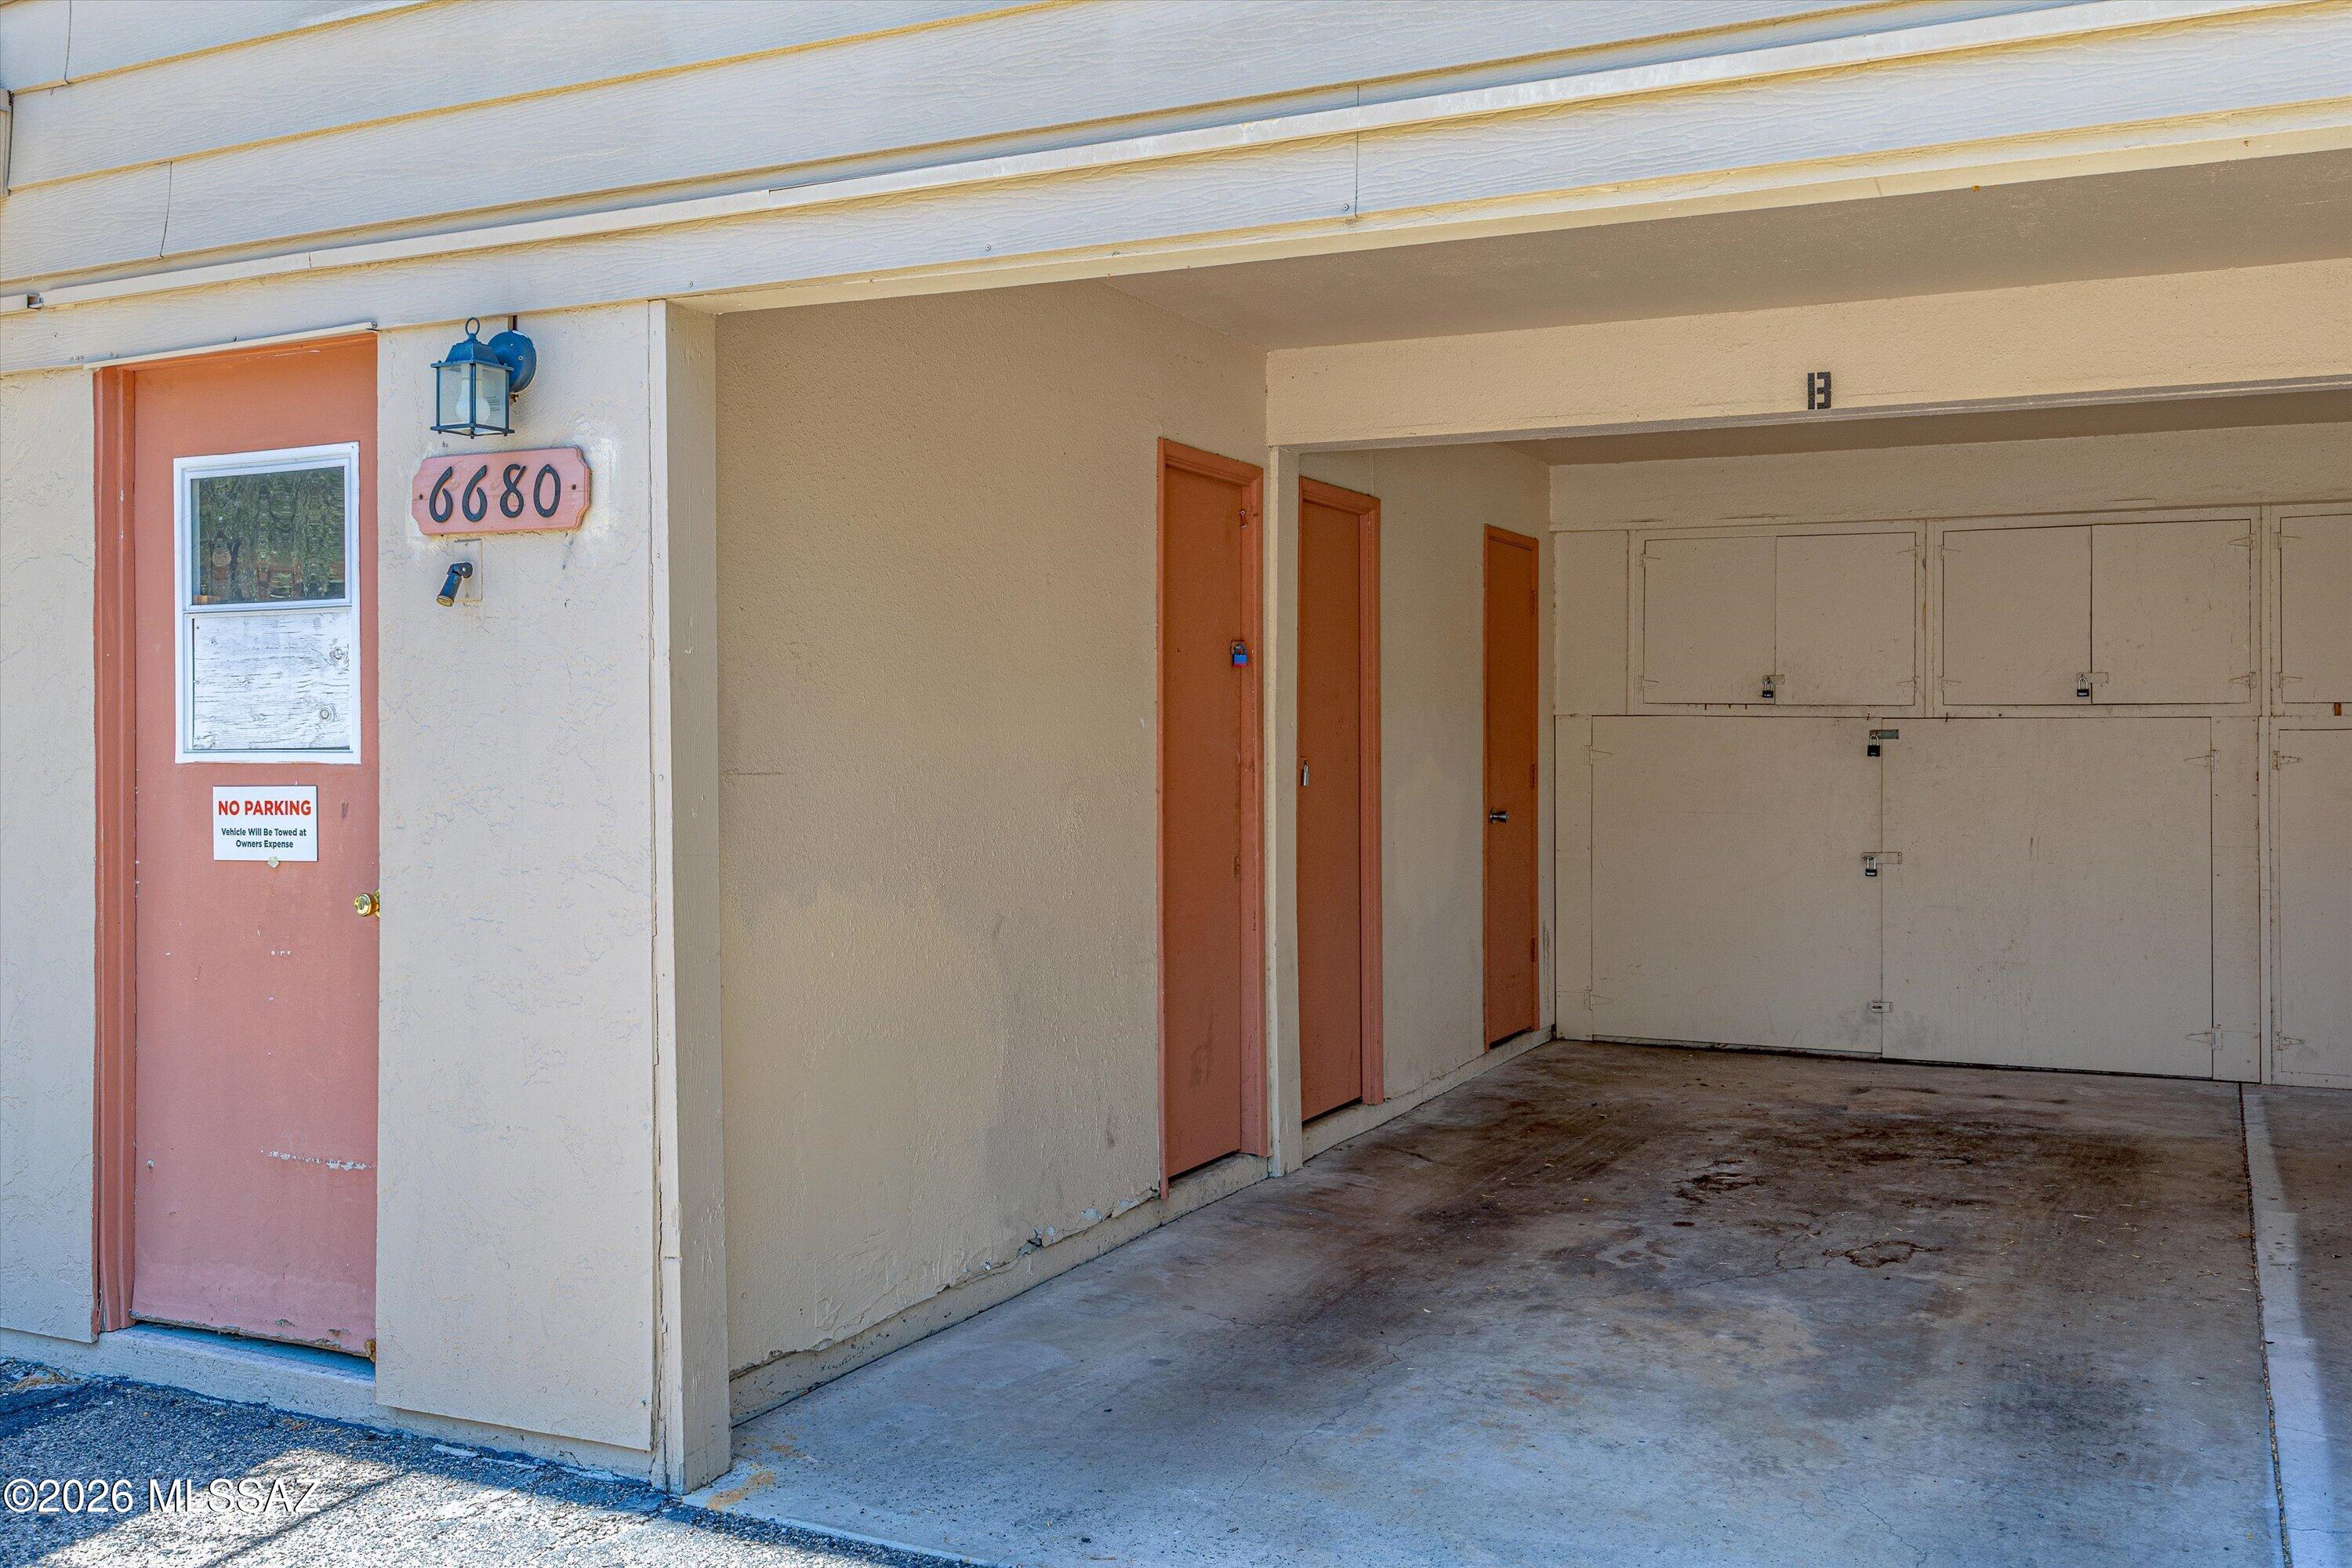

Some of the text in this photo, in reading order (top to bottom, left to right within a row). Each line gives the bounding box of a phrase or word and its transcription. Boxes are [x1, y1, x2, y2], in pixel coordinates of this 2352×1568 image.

[429, 463, 561, 523] 6680
[218, 800, 311, 815] NO PARKING
[221, 828, 246, 837] Vehicle
[248, 828, 262, 837] Will
[263, 828, 273, 837] Be
[274, 828, 297, 837] Towed
[264, 840, 293, 849] Expense
